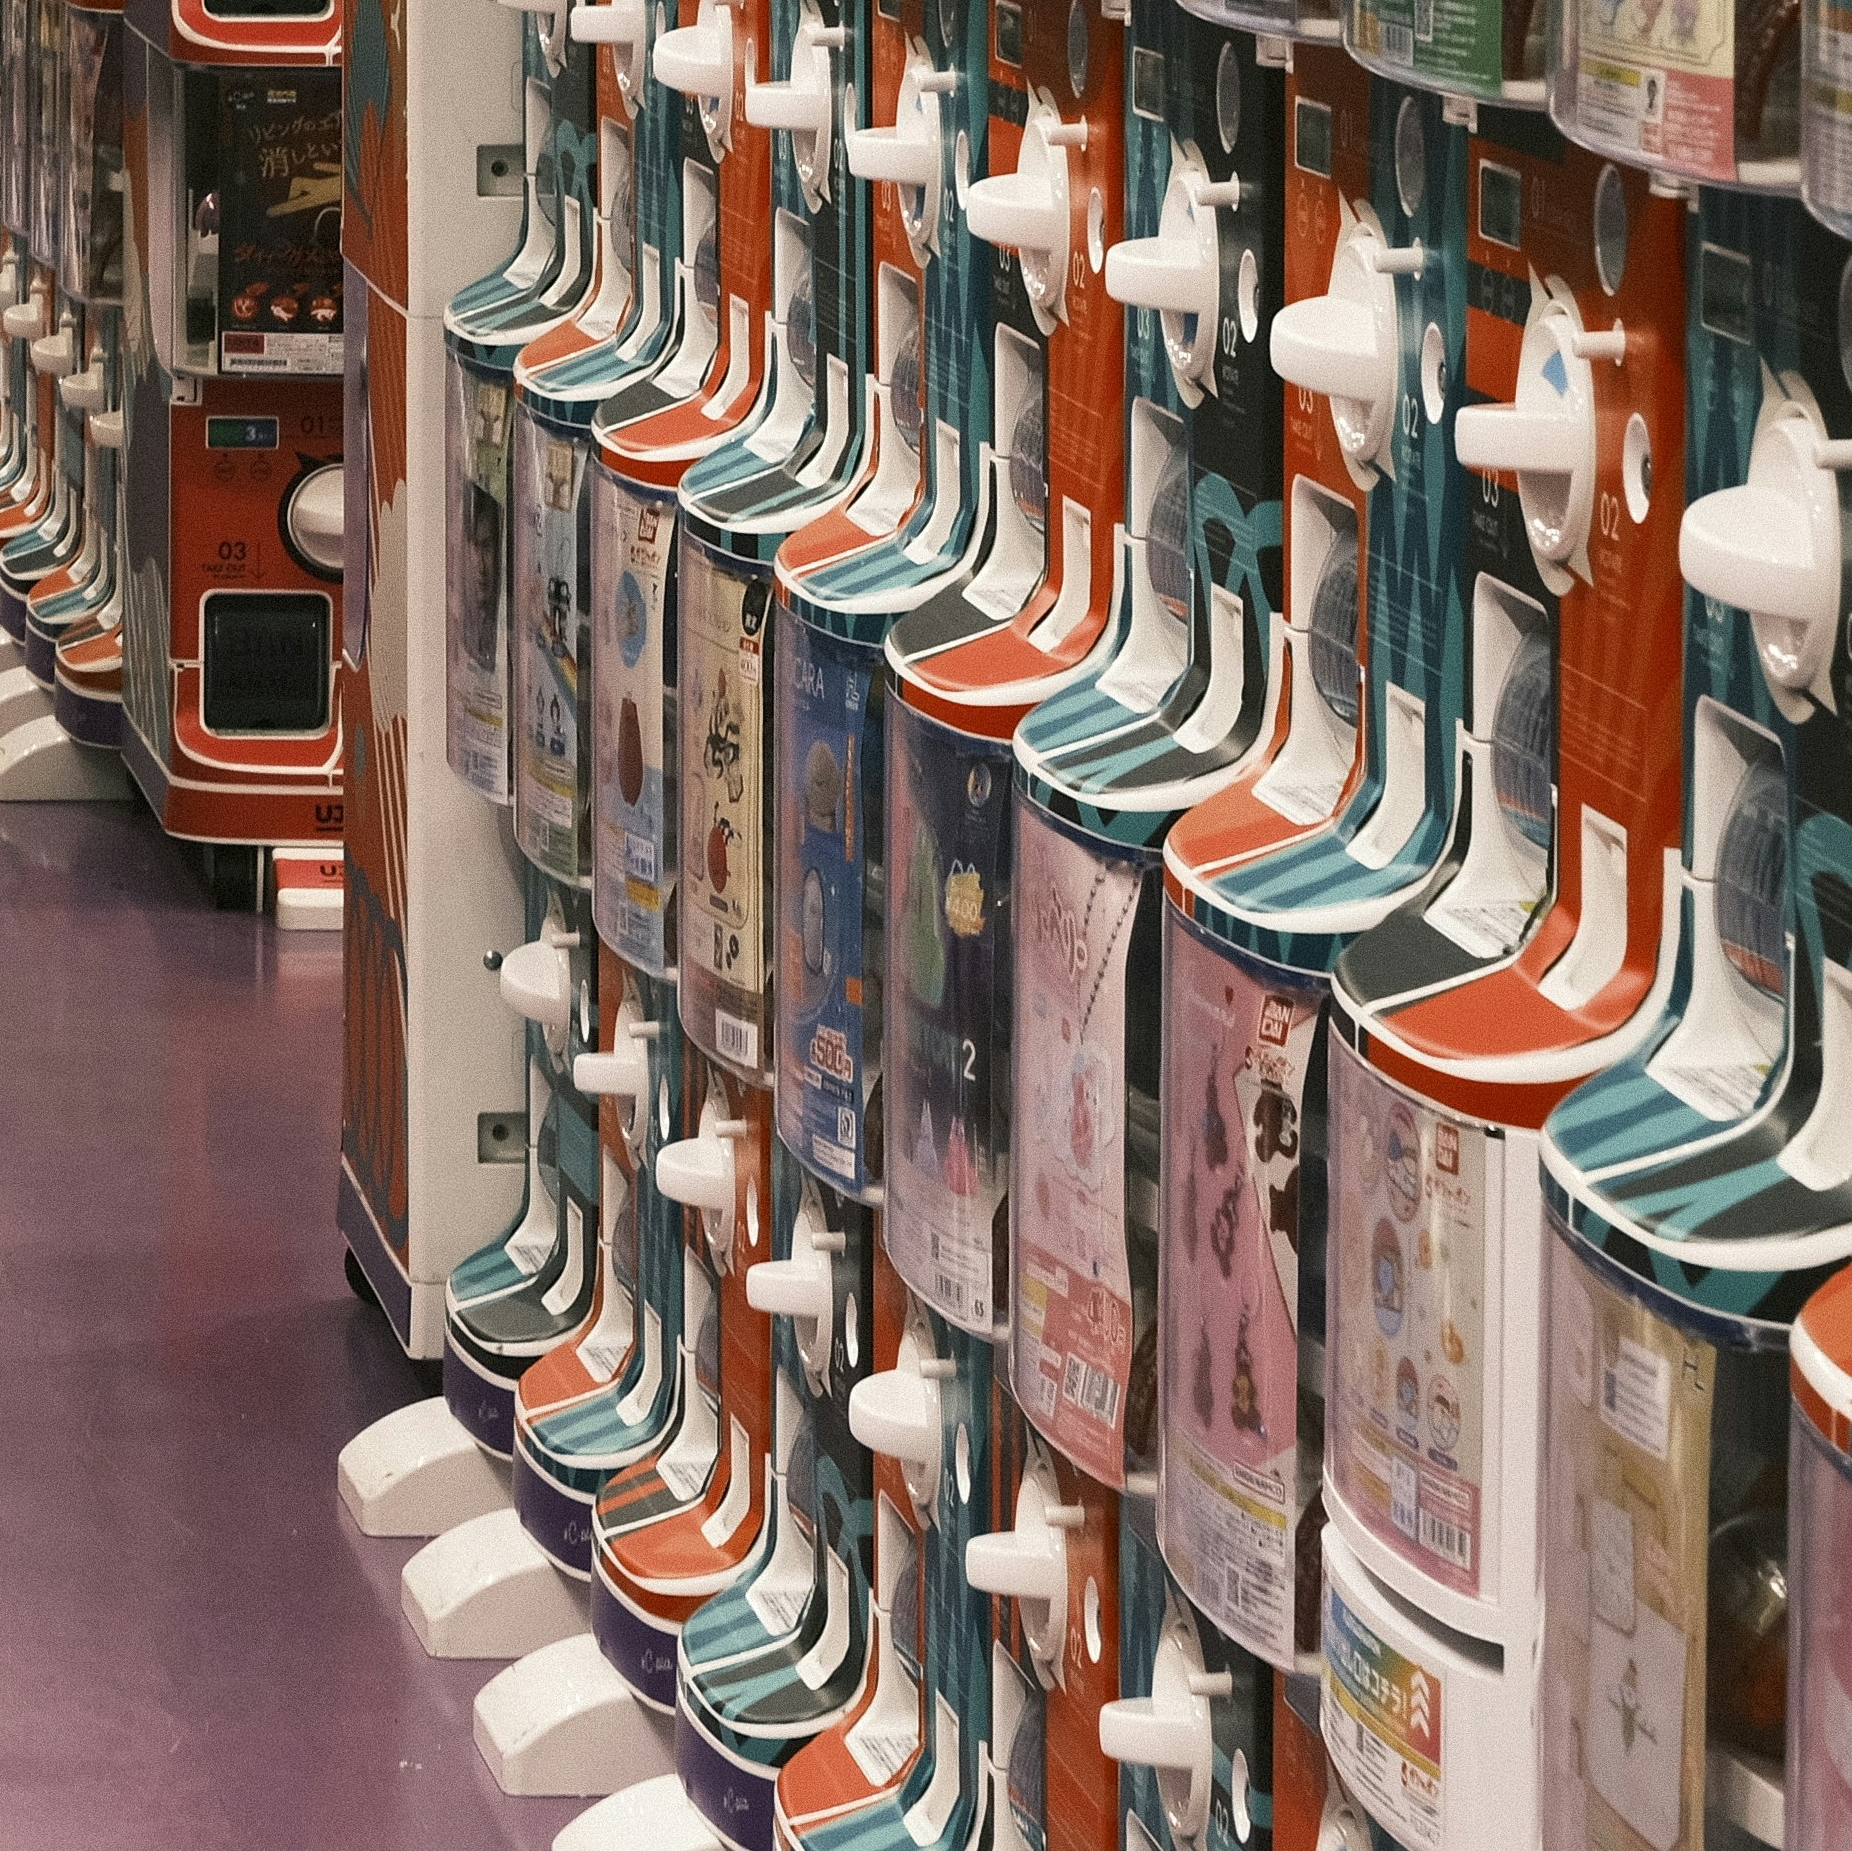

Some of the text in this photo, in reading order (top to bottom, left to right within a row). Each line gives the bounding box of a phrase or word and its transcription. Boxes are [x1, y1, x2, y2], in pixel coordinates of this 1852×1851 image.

[1401, 393, 1419, 439] 02
[1600, 491, 1620, 541] 02
[217, 541, 247, 562] 03
[962, 1038, 977, 1081] 2
